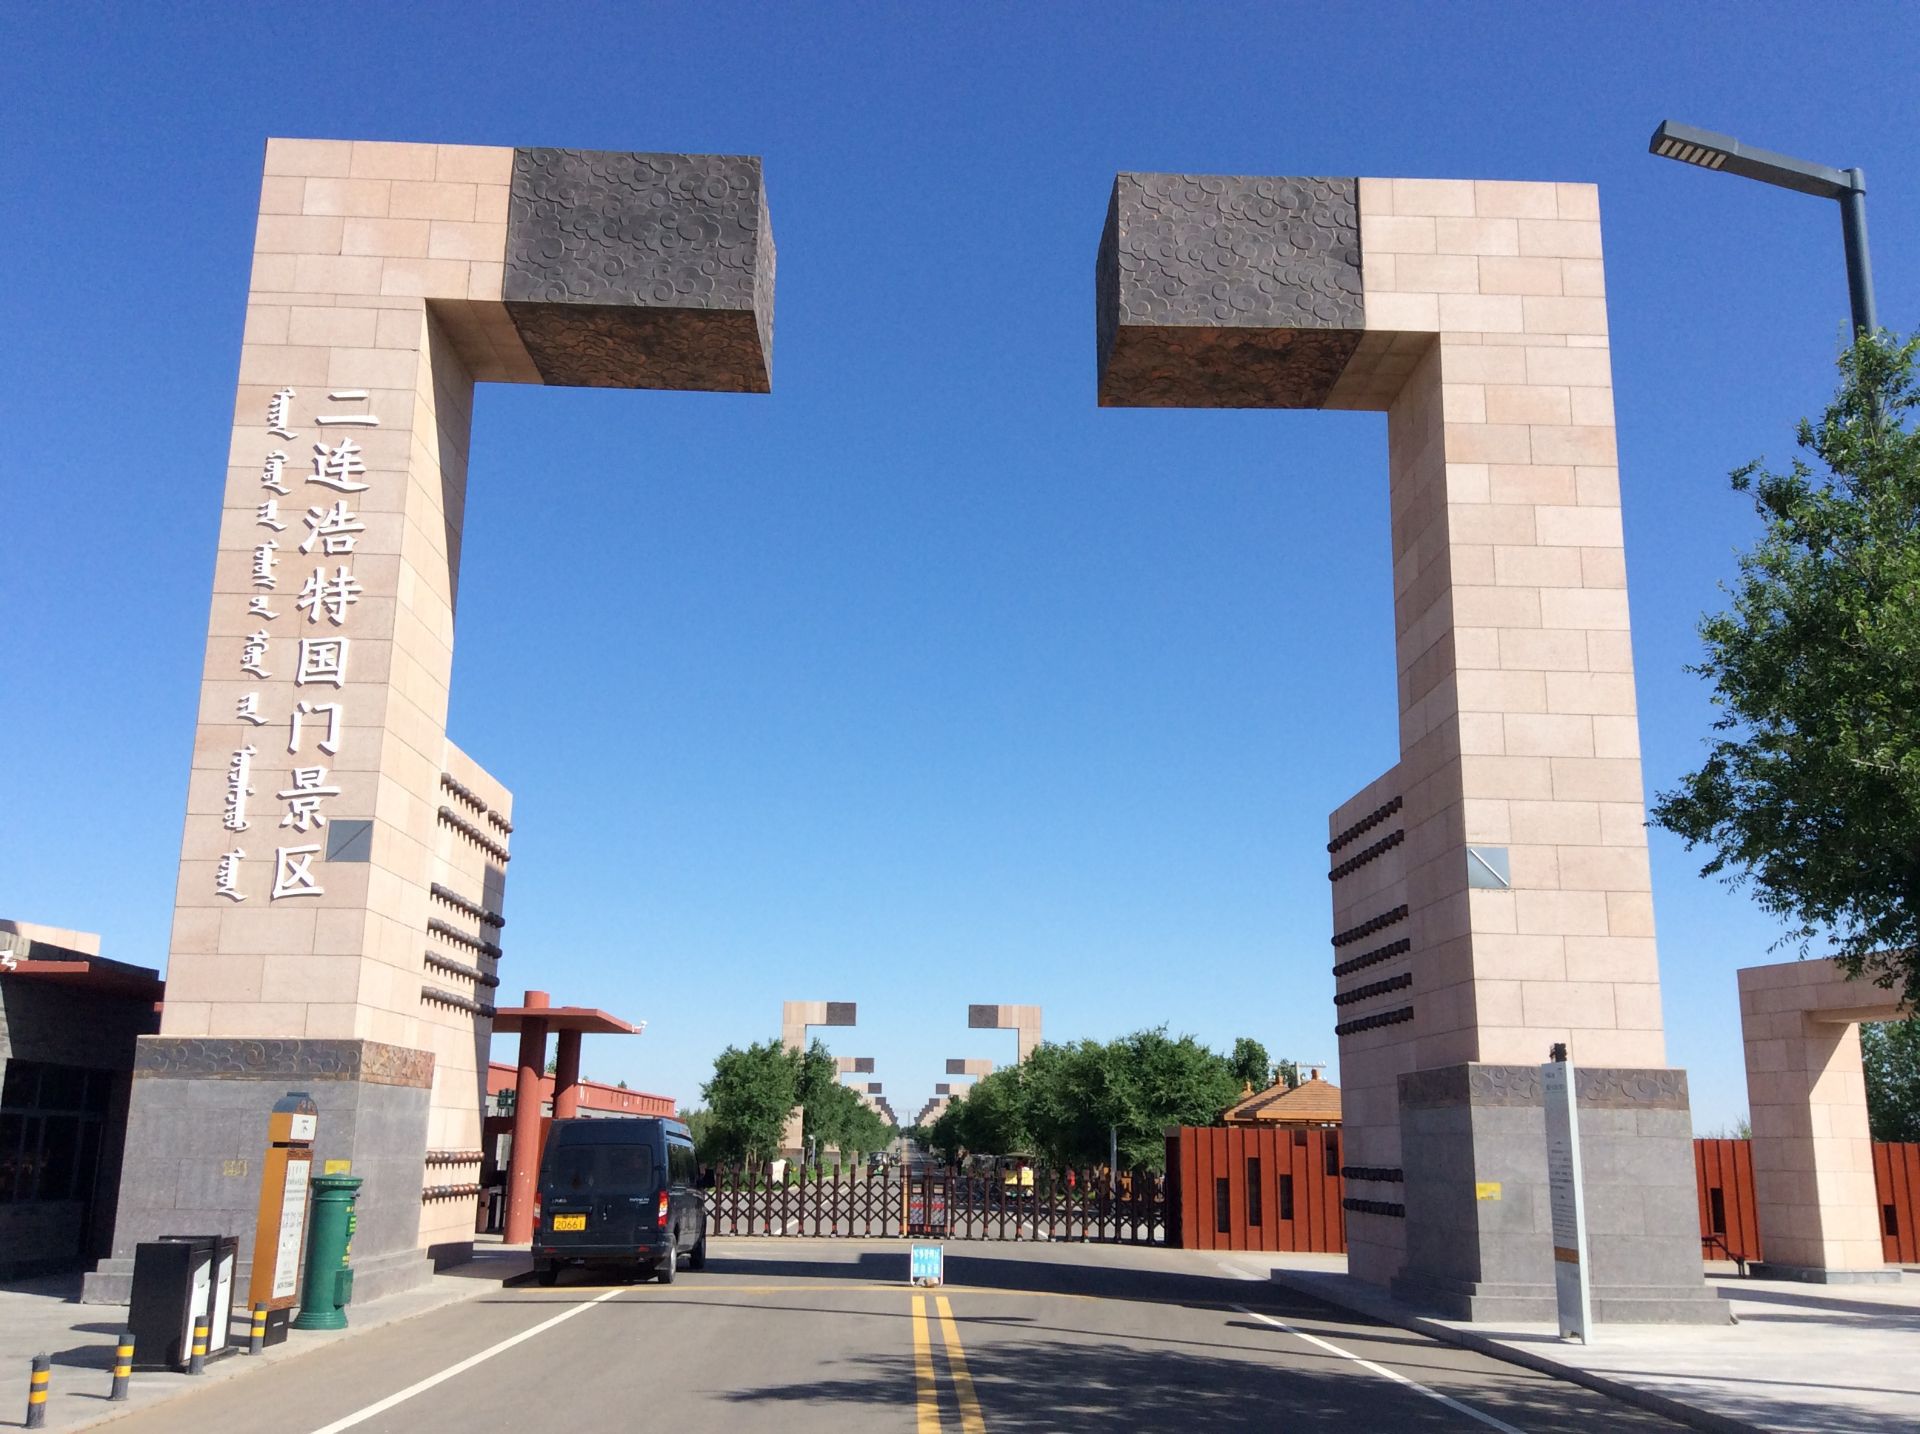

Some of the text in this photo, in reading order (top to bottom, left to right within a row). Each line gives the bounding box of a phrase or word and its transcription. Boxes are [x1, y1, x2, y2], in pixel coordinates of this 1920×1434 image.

[271, 389, 379, 901] 二连浩特国门景区
[556, 1220, 582, 1230] 20661
